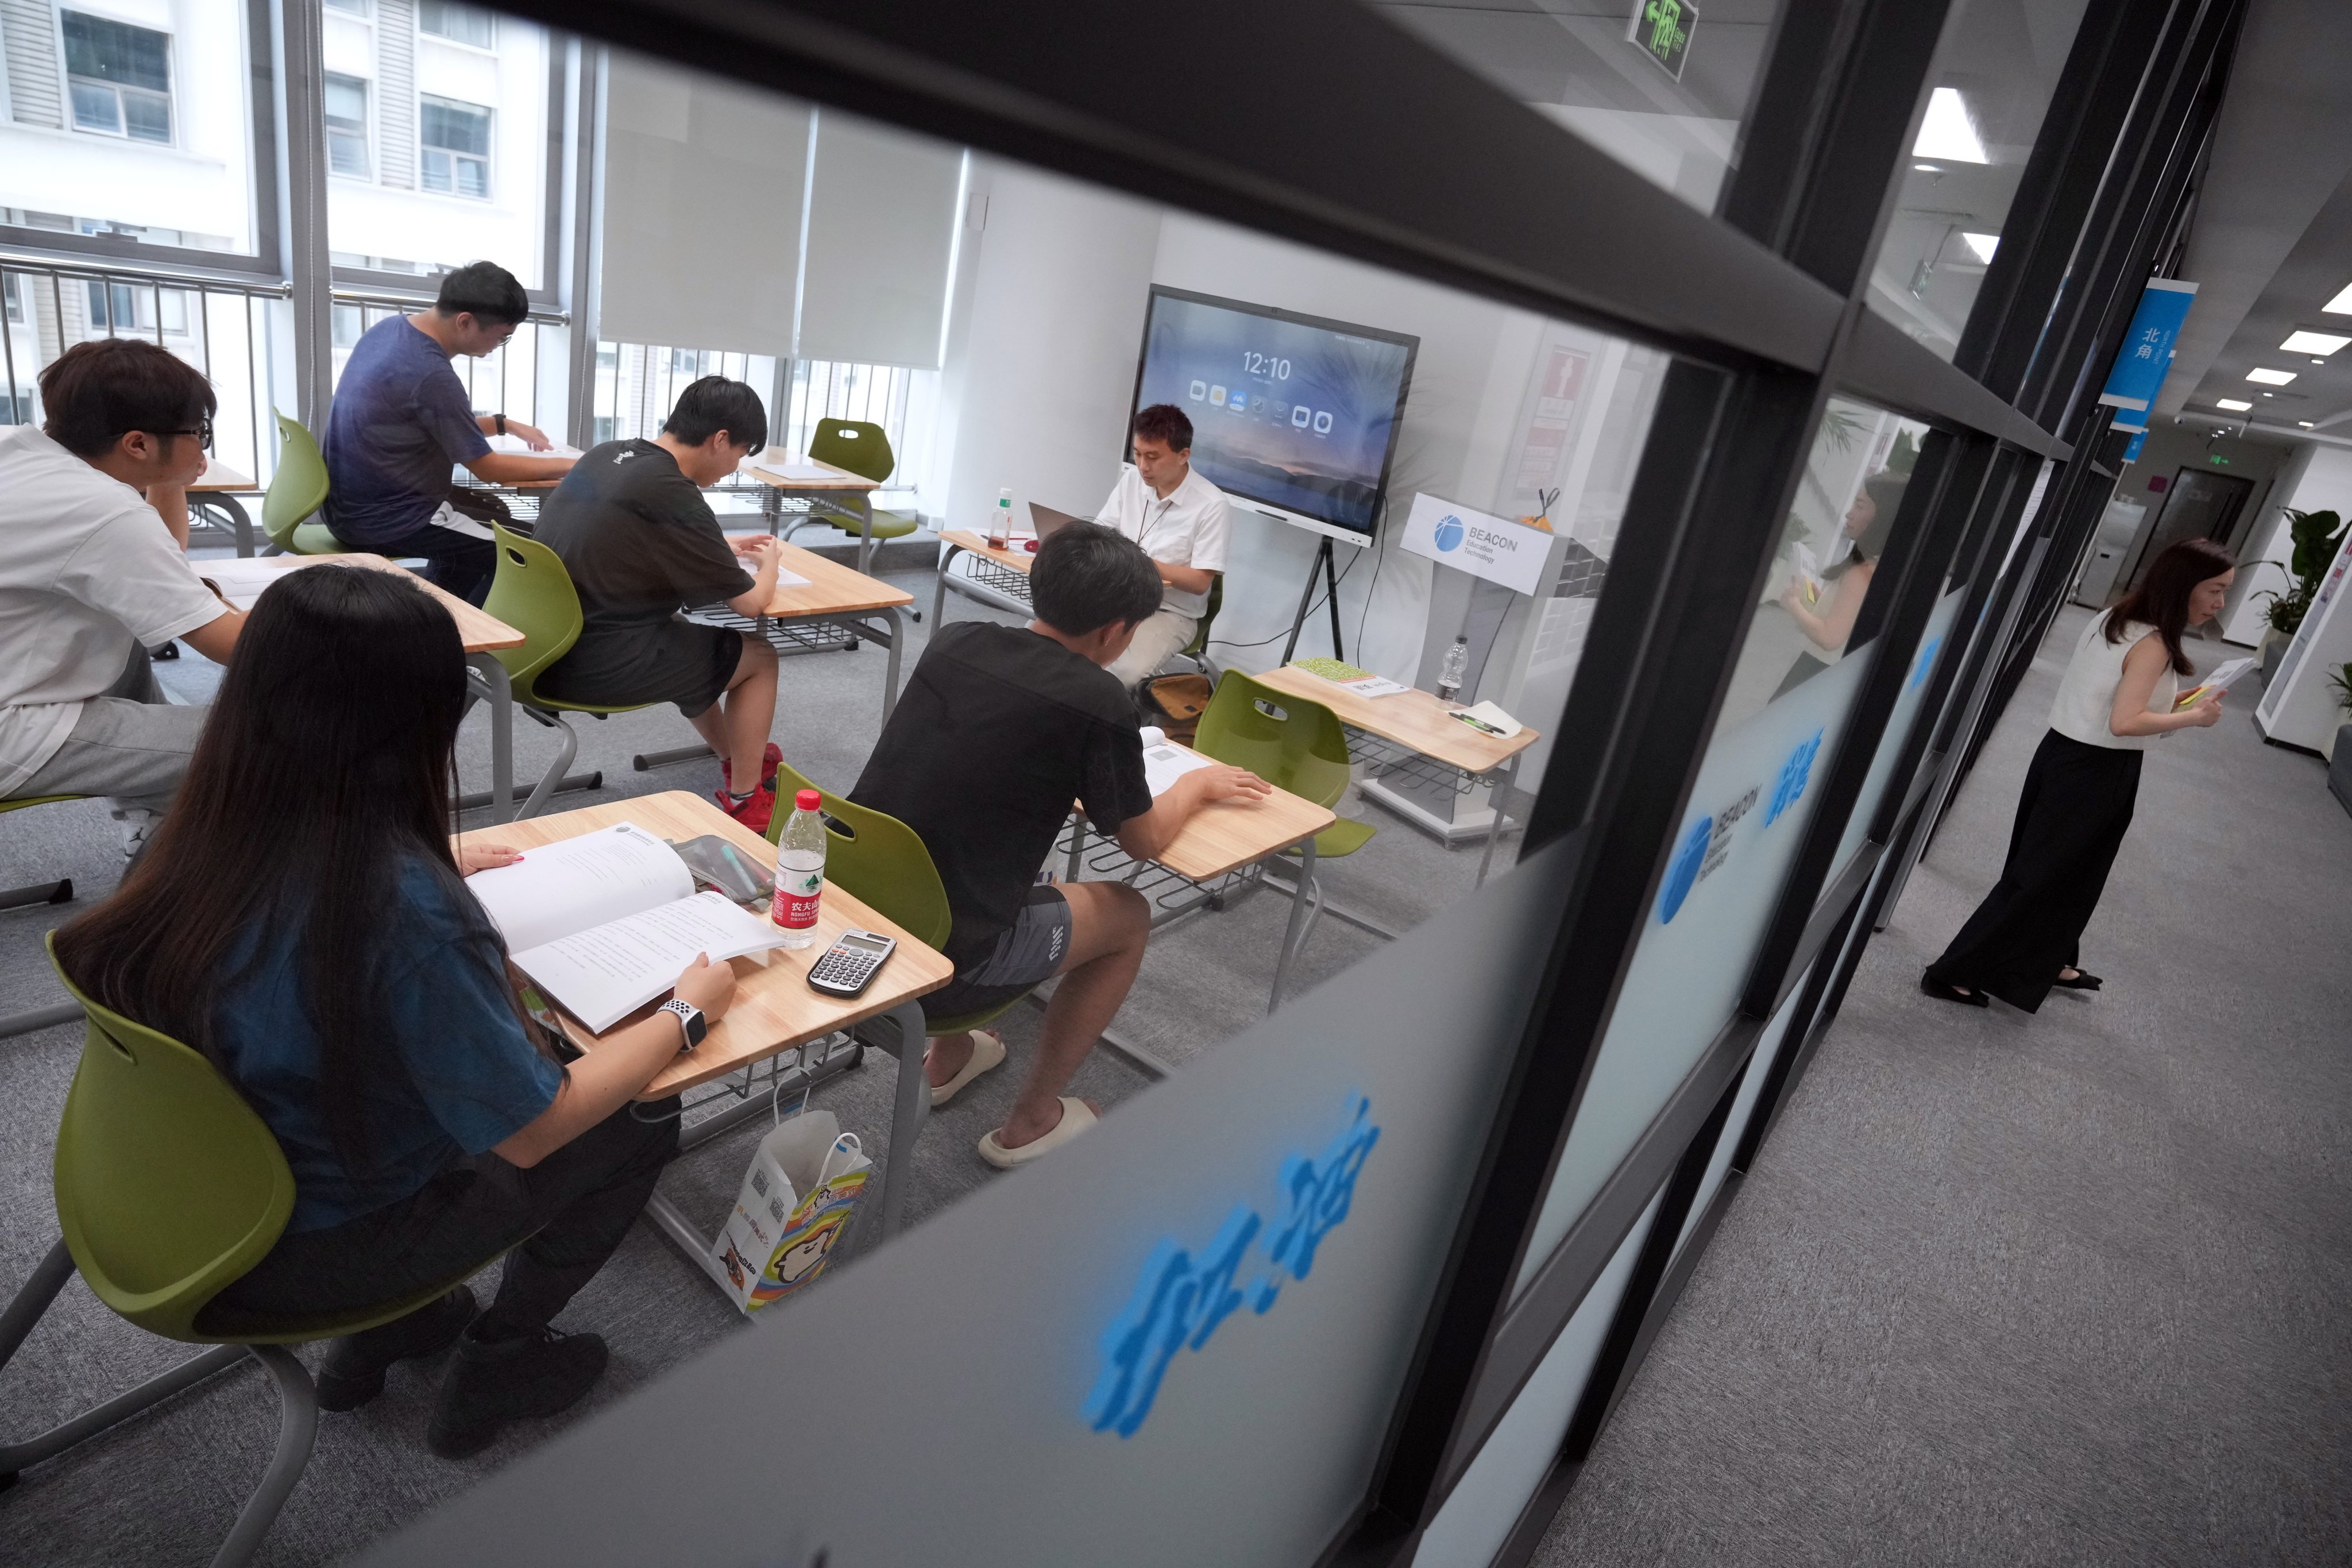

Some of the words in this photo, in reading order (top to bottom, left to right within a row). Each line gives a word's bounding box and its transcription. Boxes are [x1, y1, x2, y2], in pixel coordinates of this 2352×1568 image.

[2134, 327, 2161, 359] 北角
[2160, 330, 2171, 348] NORTH
[1244, 351, 1291, 380] 12:10
[2152, 349, 2164, 365] POINT
[1466, 539, 1493, 554] Education
[1469, 527, 1518, 552] BEACON
[1465, 547, 1494, 564] Technology
[791, 899, 820, 912] 农夫山
